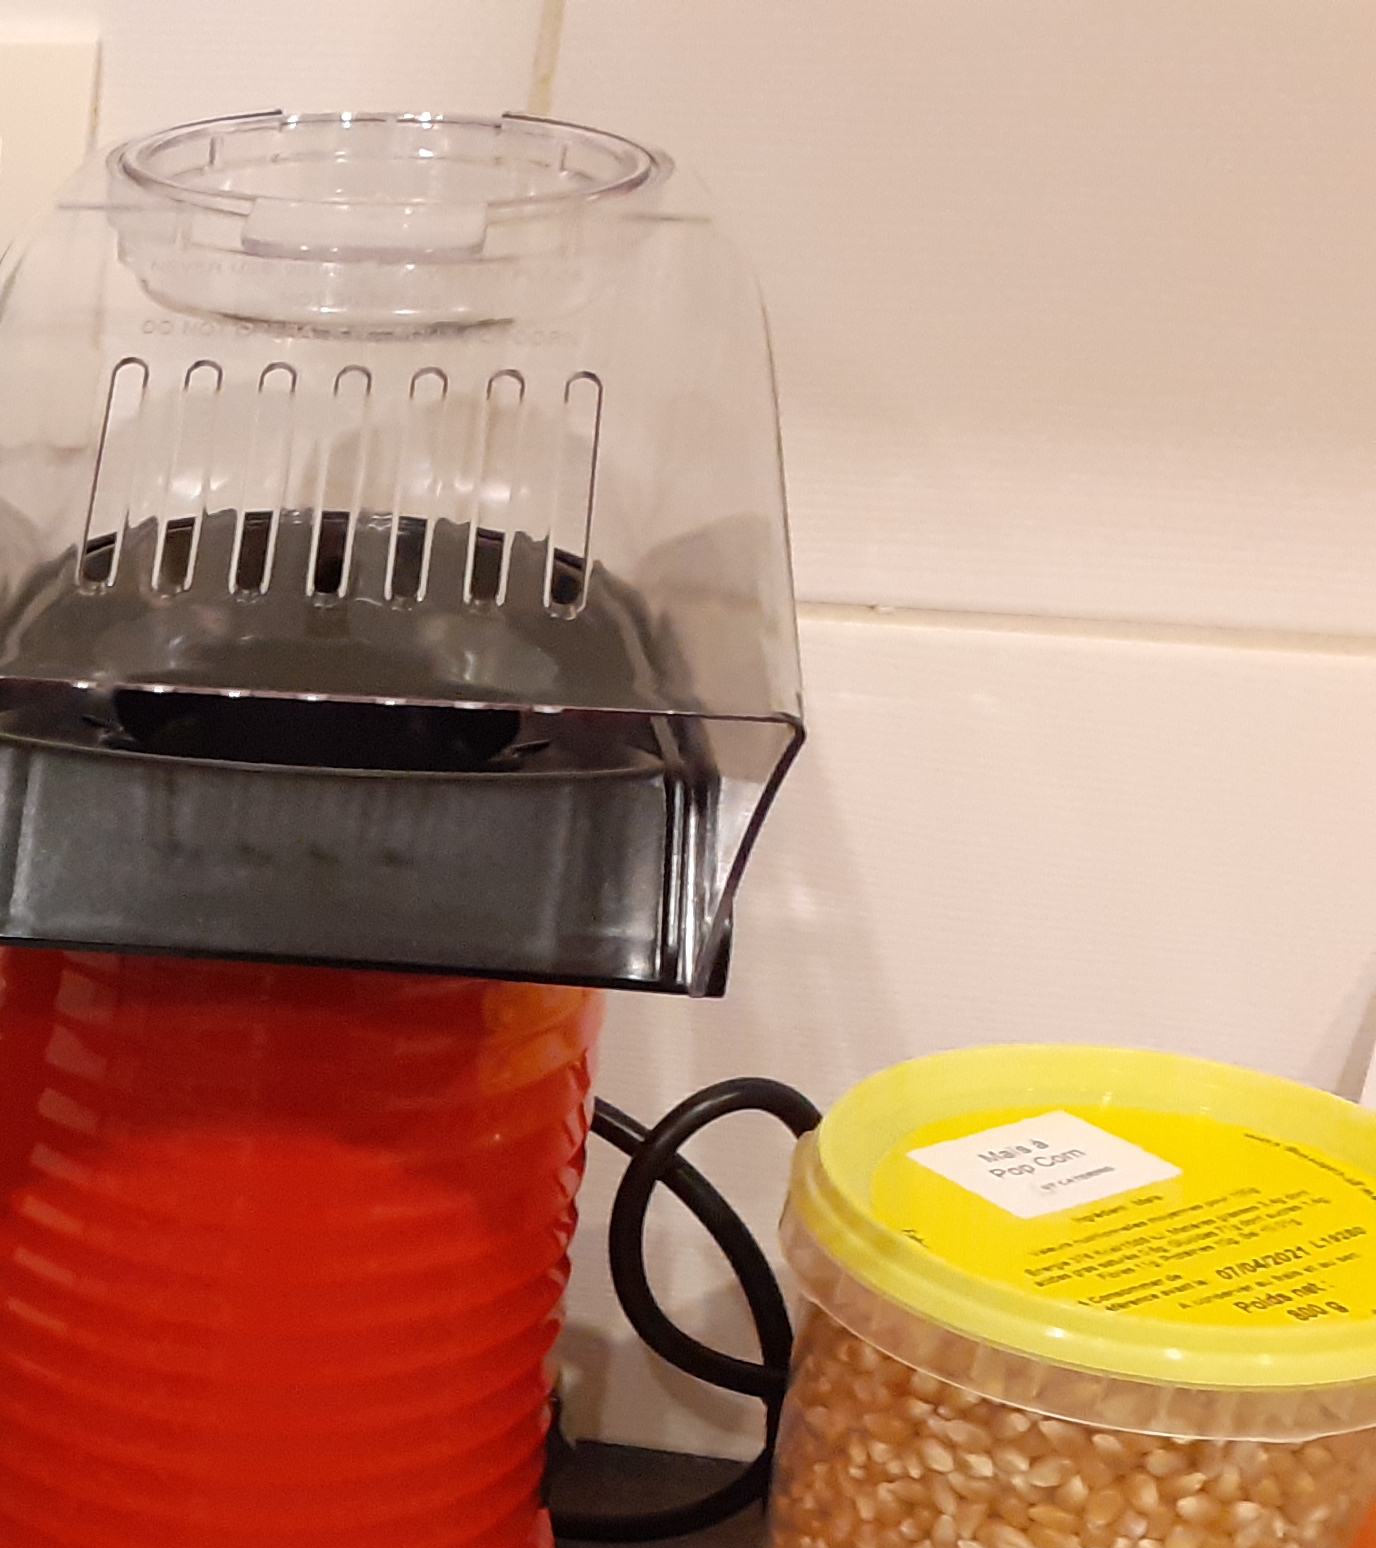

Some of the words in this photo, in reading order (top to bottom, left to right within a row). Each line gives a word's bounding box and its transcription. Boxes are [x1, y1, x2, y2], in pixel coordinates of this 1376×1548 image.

[989, 1163, 1036, 1181] Pop
[1032, 1148, 1087, 1168] Corn
[1214, 1245, 1312, 1281] 07/04/2021
[1232, 1292, 1295, 1315] Poids
[1290, 1282, 1327, 1298] net
[1324, 1301, 1350, 1314] g
